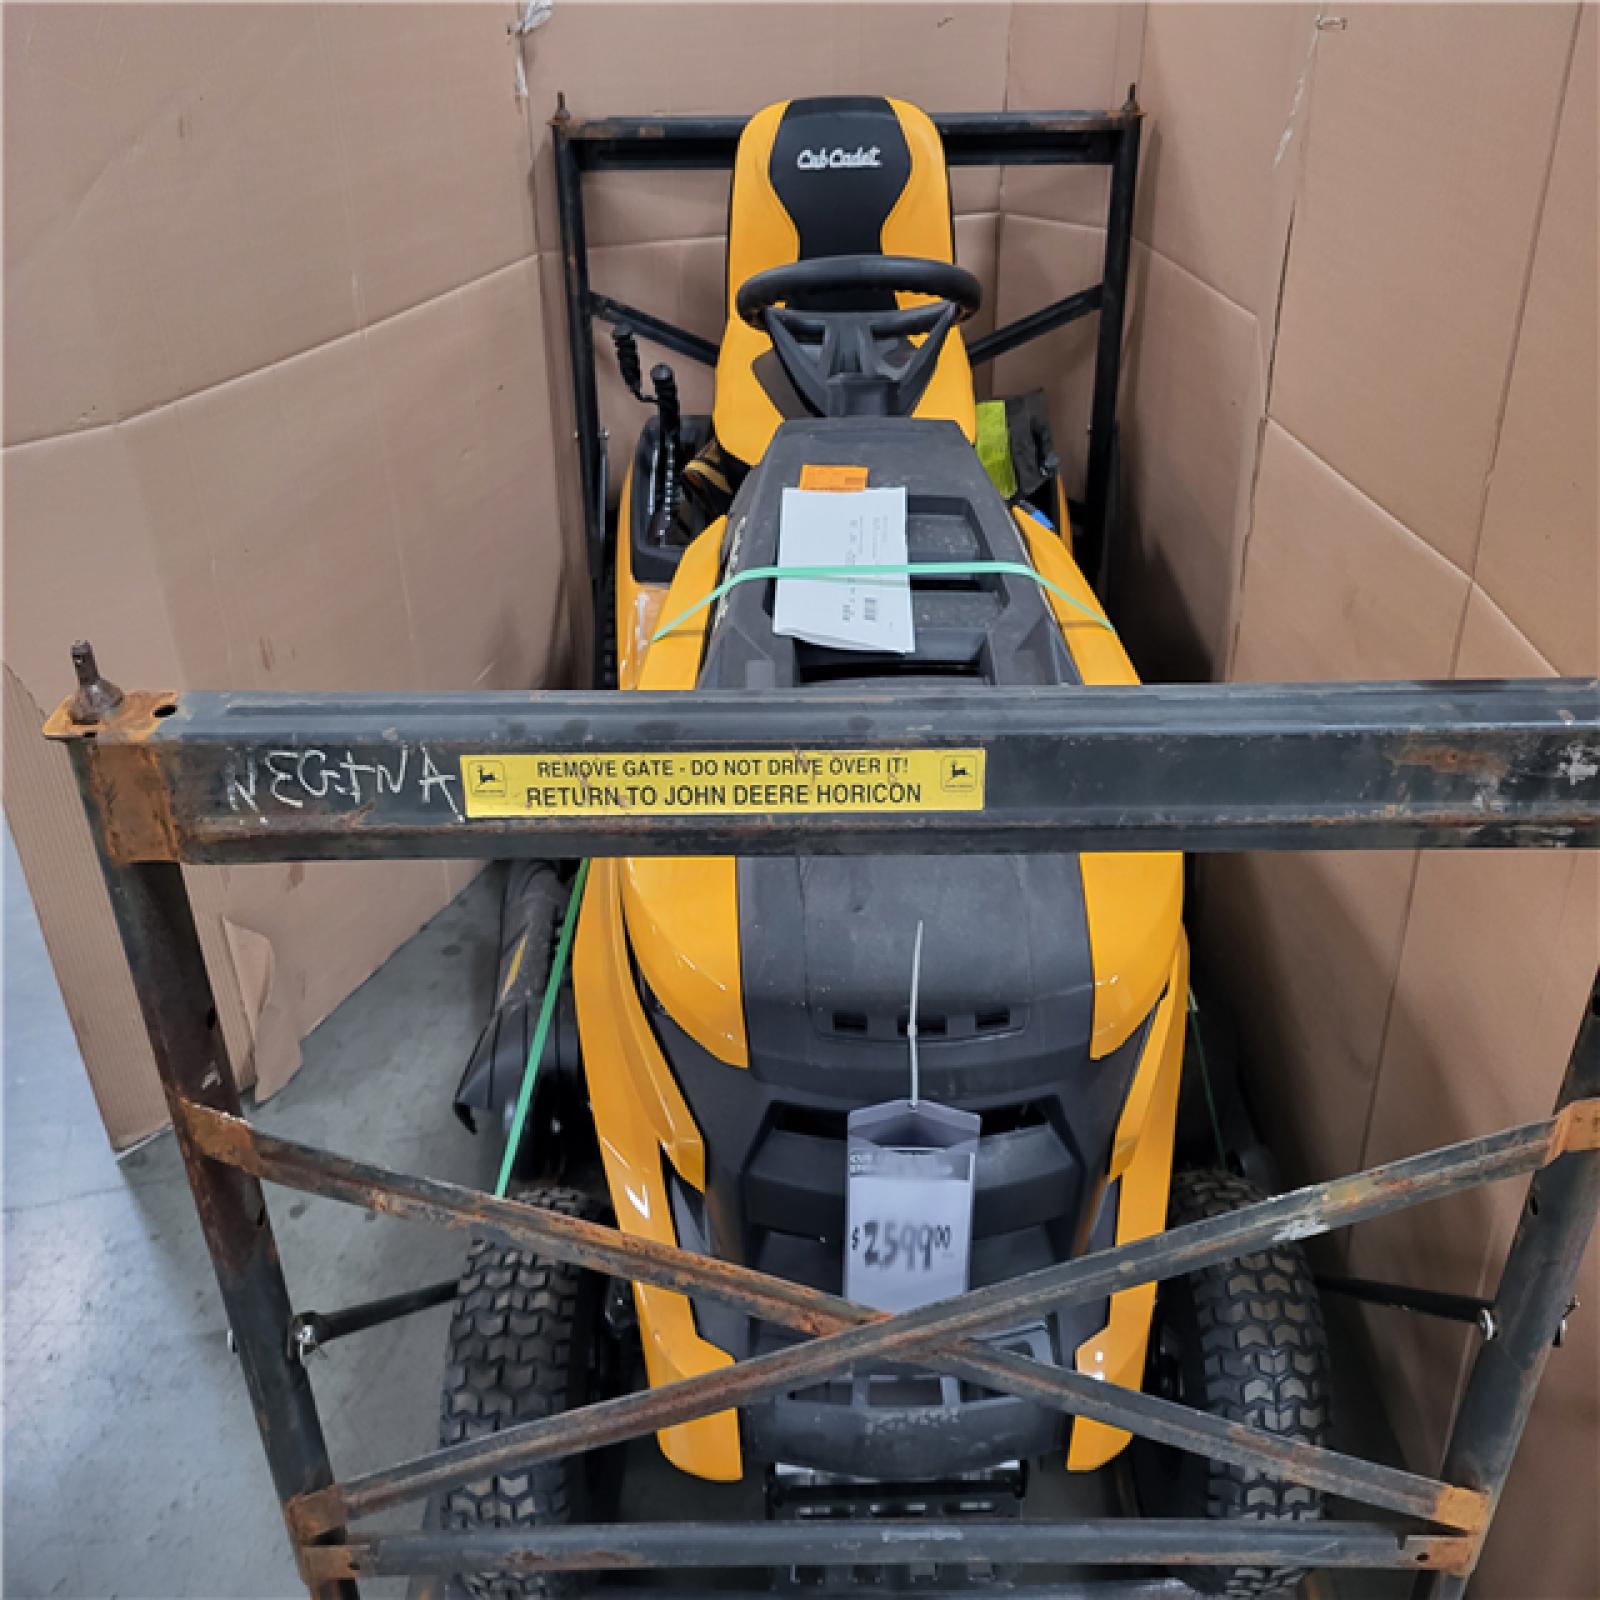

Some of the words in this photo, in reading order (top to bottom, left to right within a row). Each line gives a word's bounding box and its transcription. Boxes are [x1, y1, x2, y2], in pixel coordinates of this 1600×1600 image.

[537, 759, 617, 778] REMOVE
[623, 759, 673, 777] GATE
[691, 759, 718, 776] DO
[724, 759, 762, 776] NOT
[768, 757, 823, 775] DRIVE
[829, 757, 881, 774] OVER
[887, 757, 909, 773] IT!
[527, 786, 618, 807] RETURN
[625, 786, 657, 805] TO
[665, 785, 726, 805] JOHN
[734, 784, 809, 805] DEERE
[817, 783, 921, 803] HORICON
